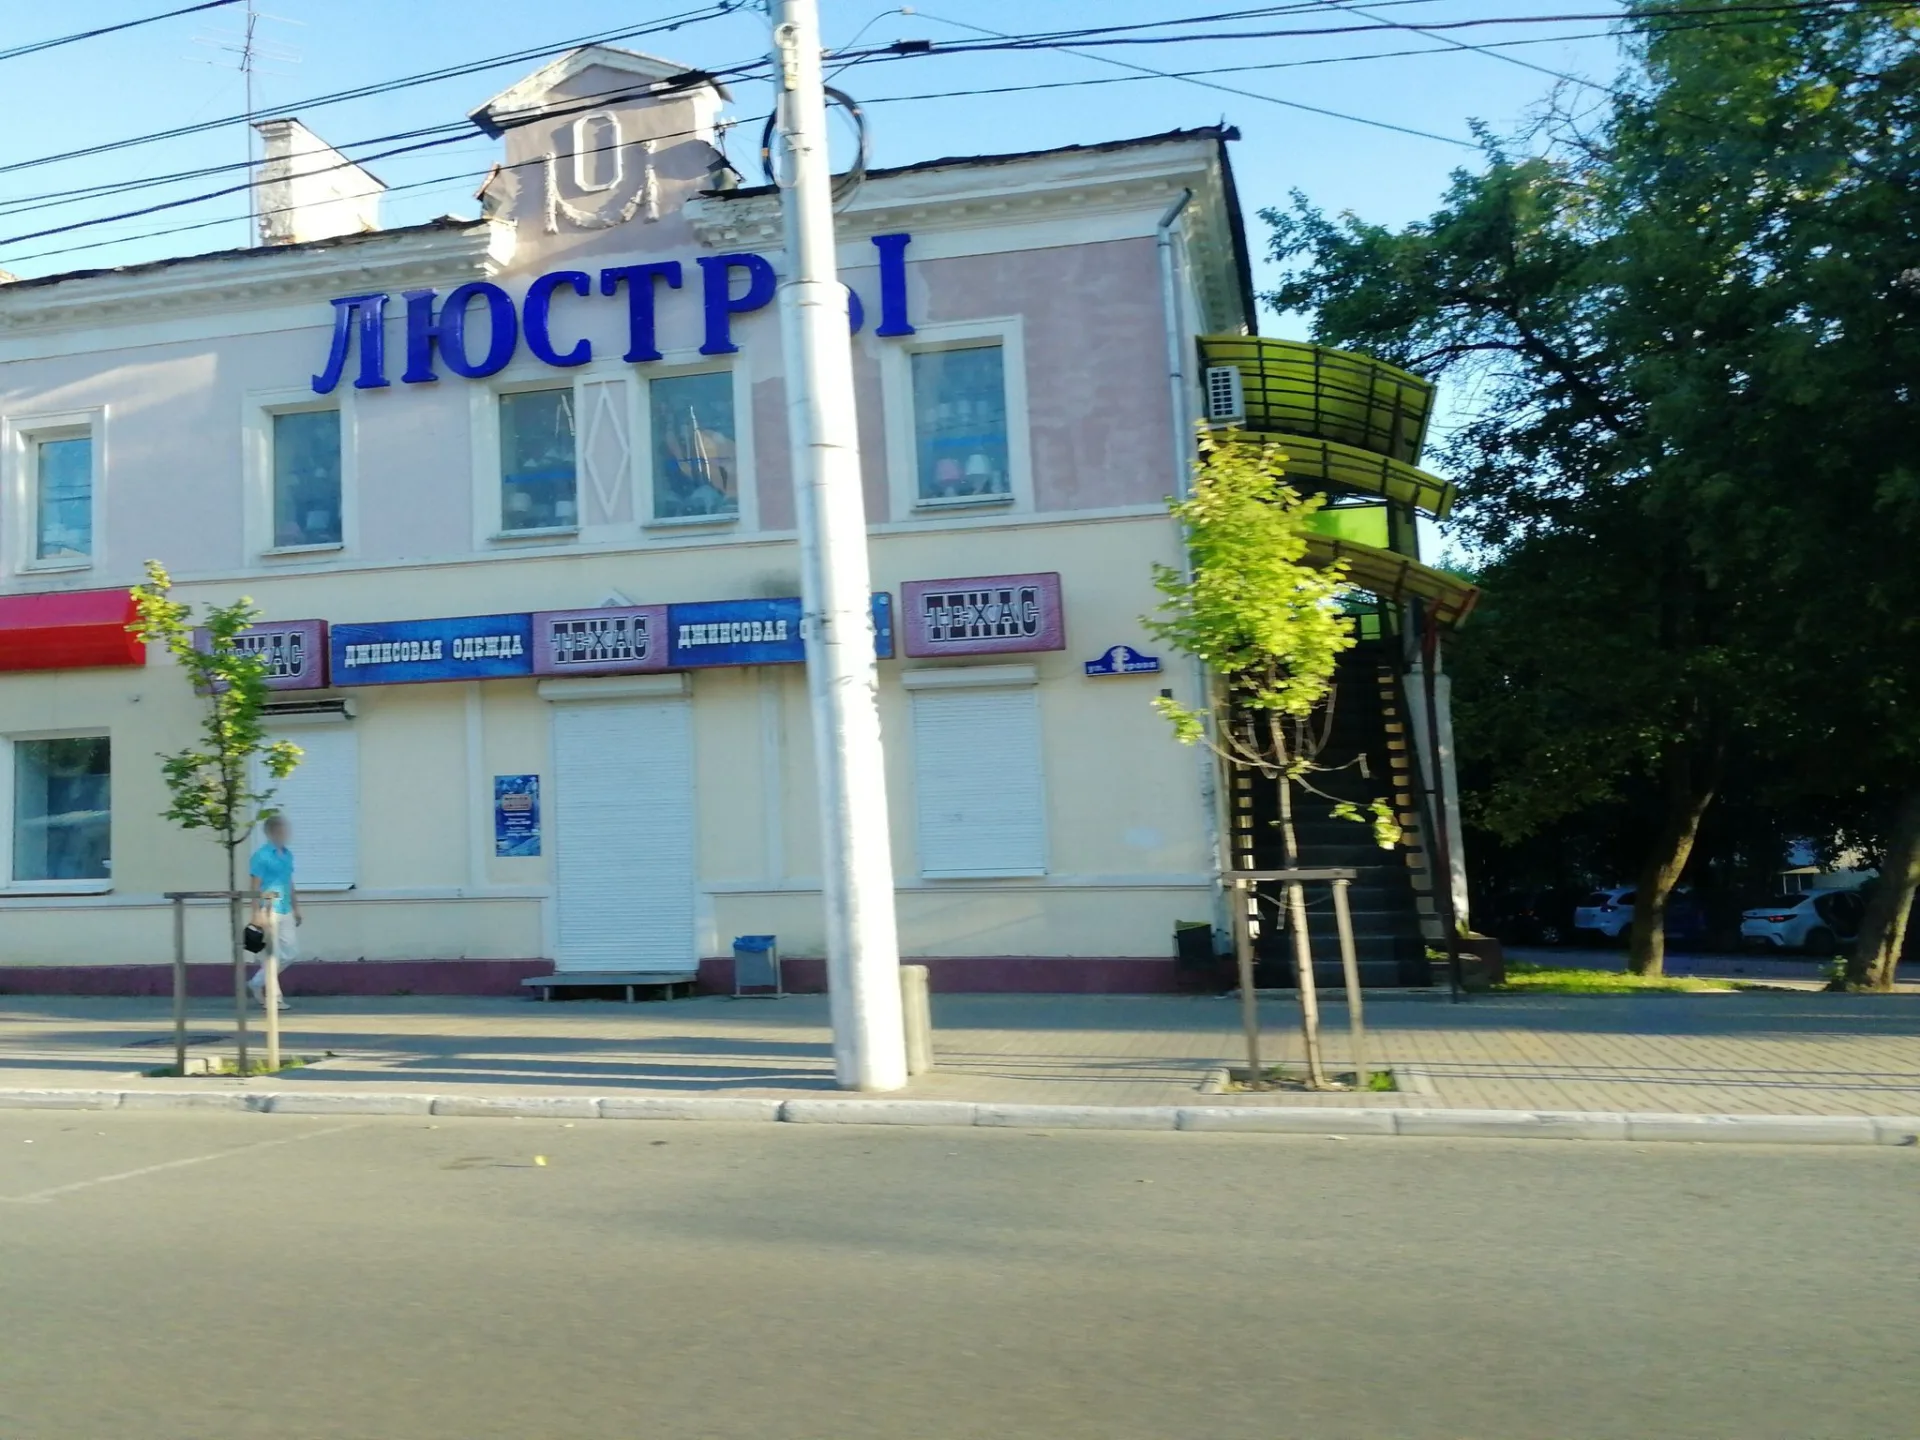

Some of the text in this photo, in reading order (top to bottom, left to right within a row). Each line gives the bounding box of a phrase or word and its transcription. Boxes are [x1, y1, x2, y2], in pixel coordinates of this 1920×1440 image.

[311, 233, 916, 394] ЛЮСТРЫ
[549, 614, 650, 665] ТЕХАС
[677, 619, 788, 650] ДЖИНСОВАЯ
[922, 585, 1040, 643] ТЕХАС
[344, 634, 524, 668] ДЖИНСОВАЯ ОДЕЖДА
